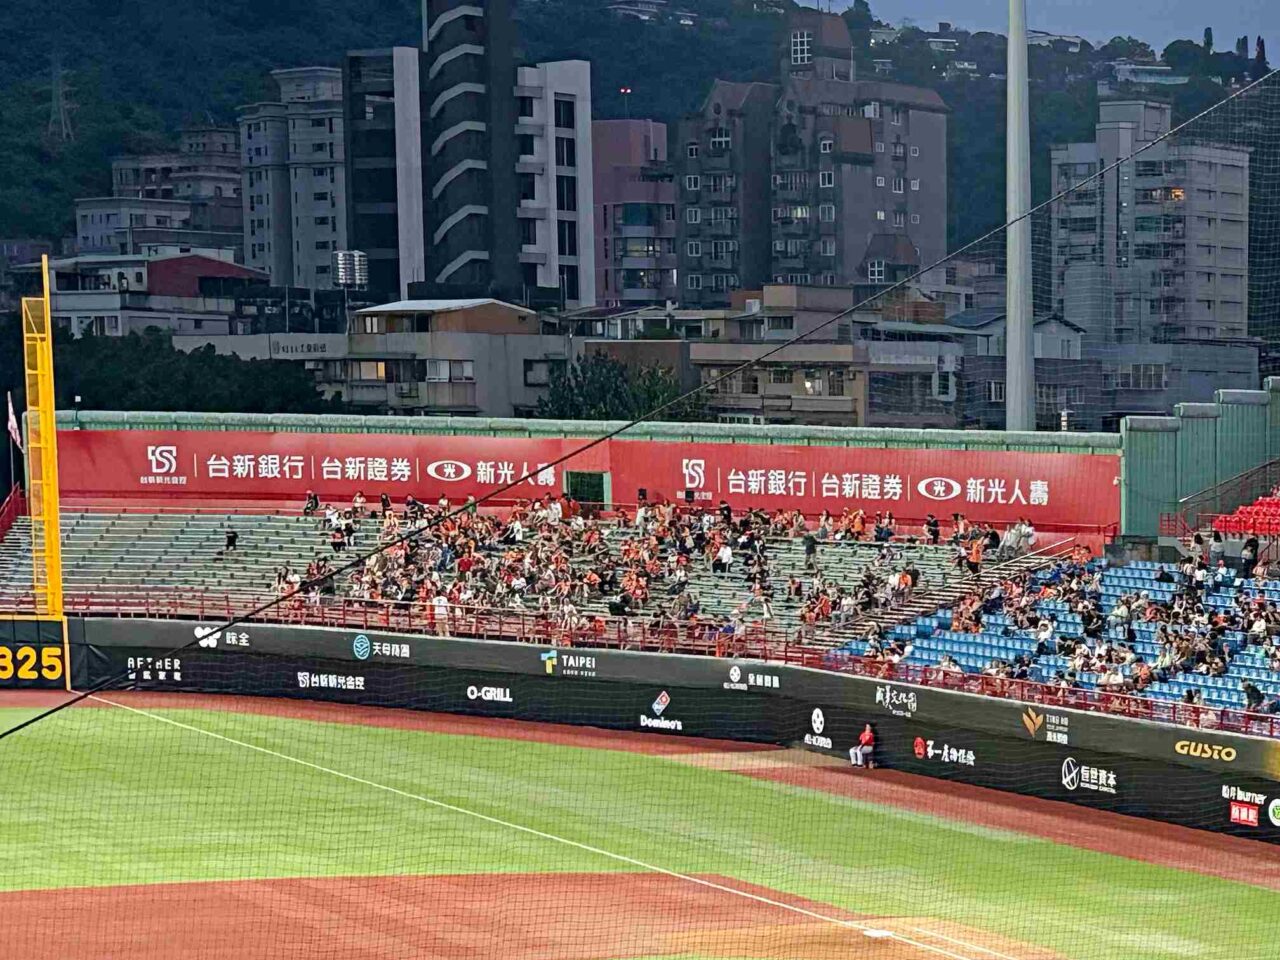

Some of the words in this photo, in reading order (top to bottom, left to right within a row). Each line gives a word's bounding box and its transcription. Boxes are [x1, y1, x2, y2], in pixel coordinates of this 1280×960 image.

[206, 454, 305, 479] 台新銀行
[321, 457, 411, 482] 台新證券
[477, 461, 556, 486] 新光人壽
[727, 469, 807, 497] 台新銀行
[821, 473, 903, 500] 台新證券
[966, 477, 1049, 506] 新光人壽
[0, 646, 62, 680] 325
[561, 654, 596, 669] TAIPEI
[467, 685, 513, 702] O-GRILL
[640, 714, 683, 731] Domino's
[1174, 740, 1237, 762] GUSTO
